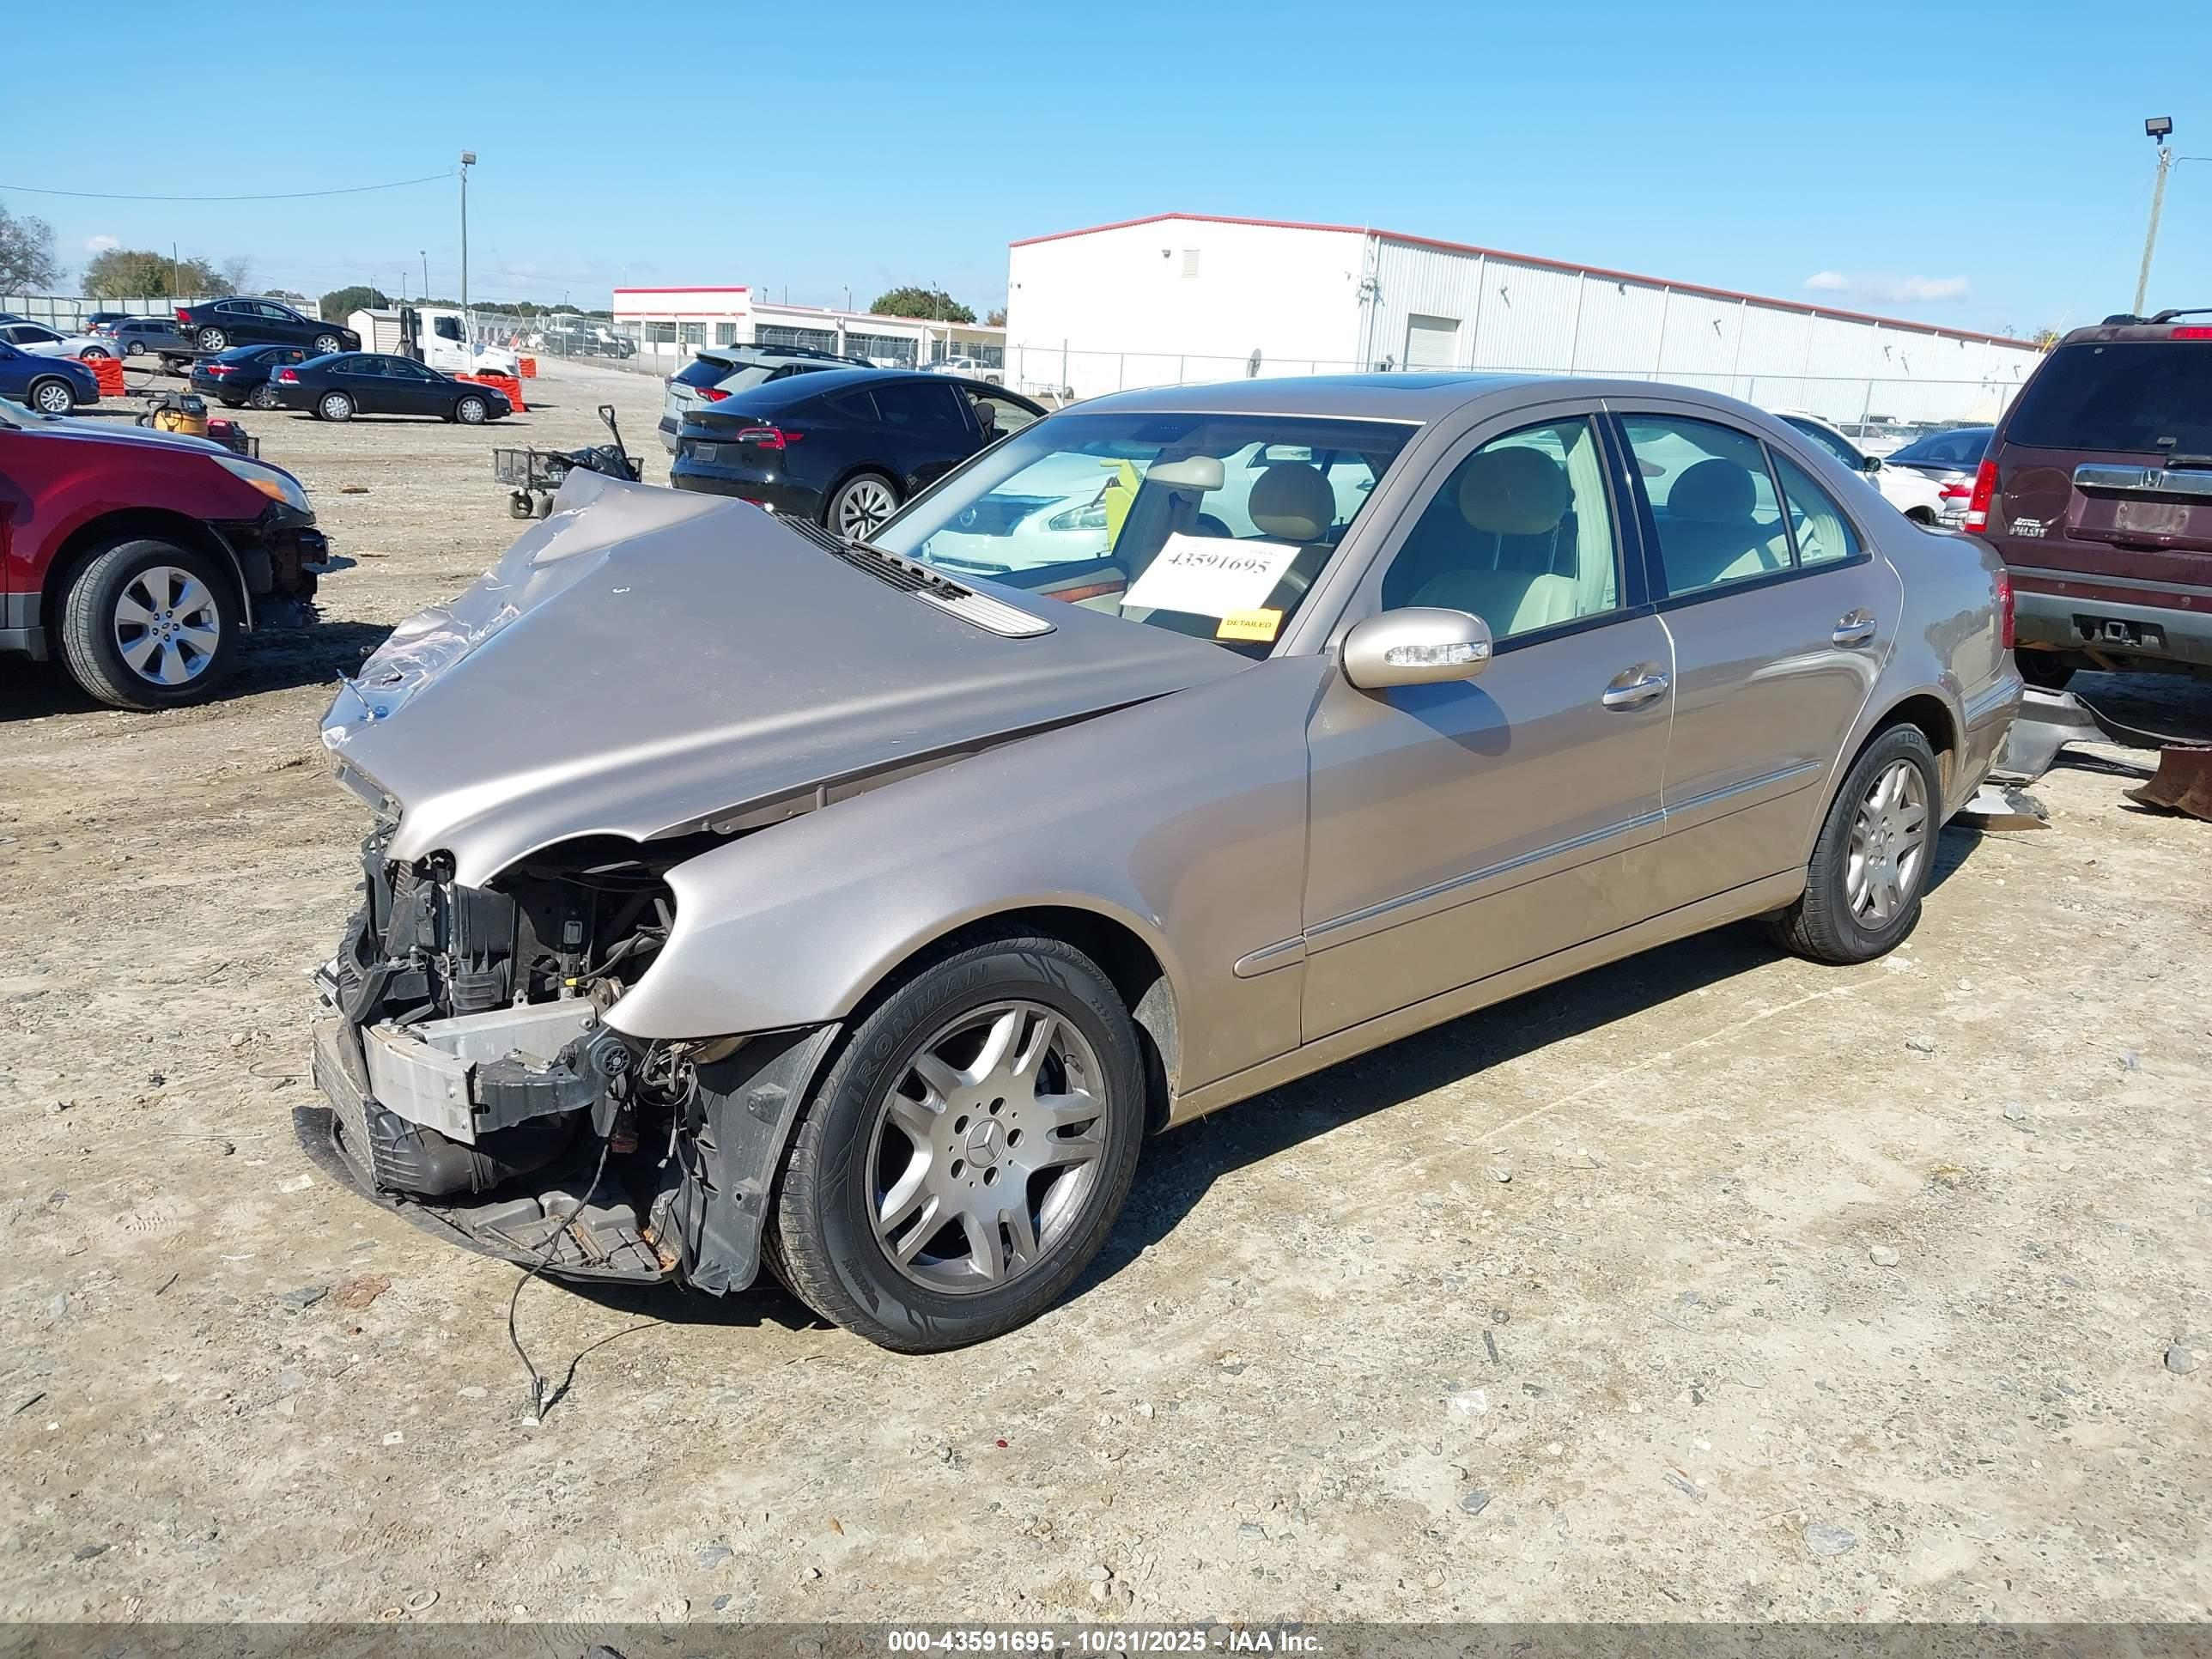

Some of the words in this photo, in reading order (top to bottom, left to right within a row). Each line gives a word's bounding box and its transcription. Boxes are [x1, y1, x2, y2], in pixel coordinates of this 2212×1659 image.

[2009, 526, 2048, 538] PILOT
[1168, 552, 1272, 574] 43591695
[1226, 619, 1272, 629] DETAILED
[848, 963, 988, 1103] IRONMAN
